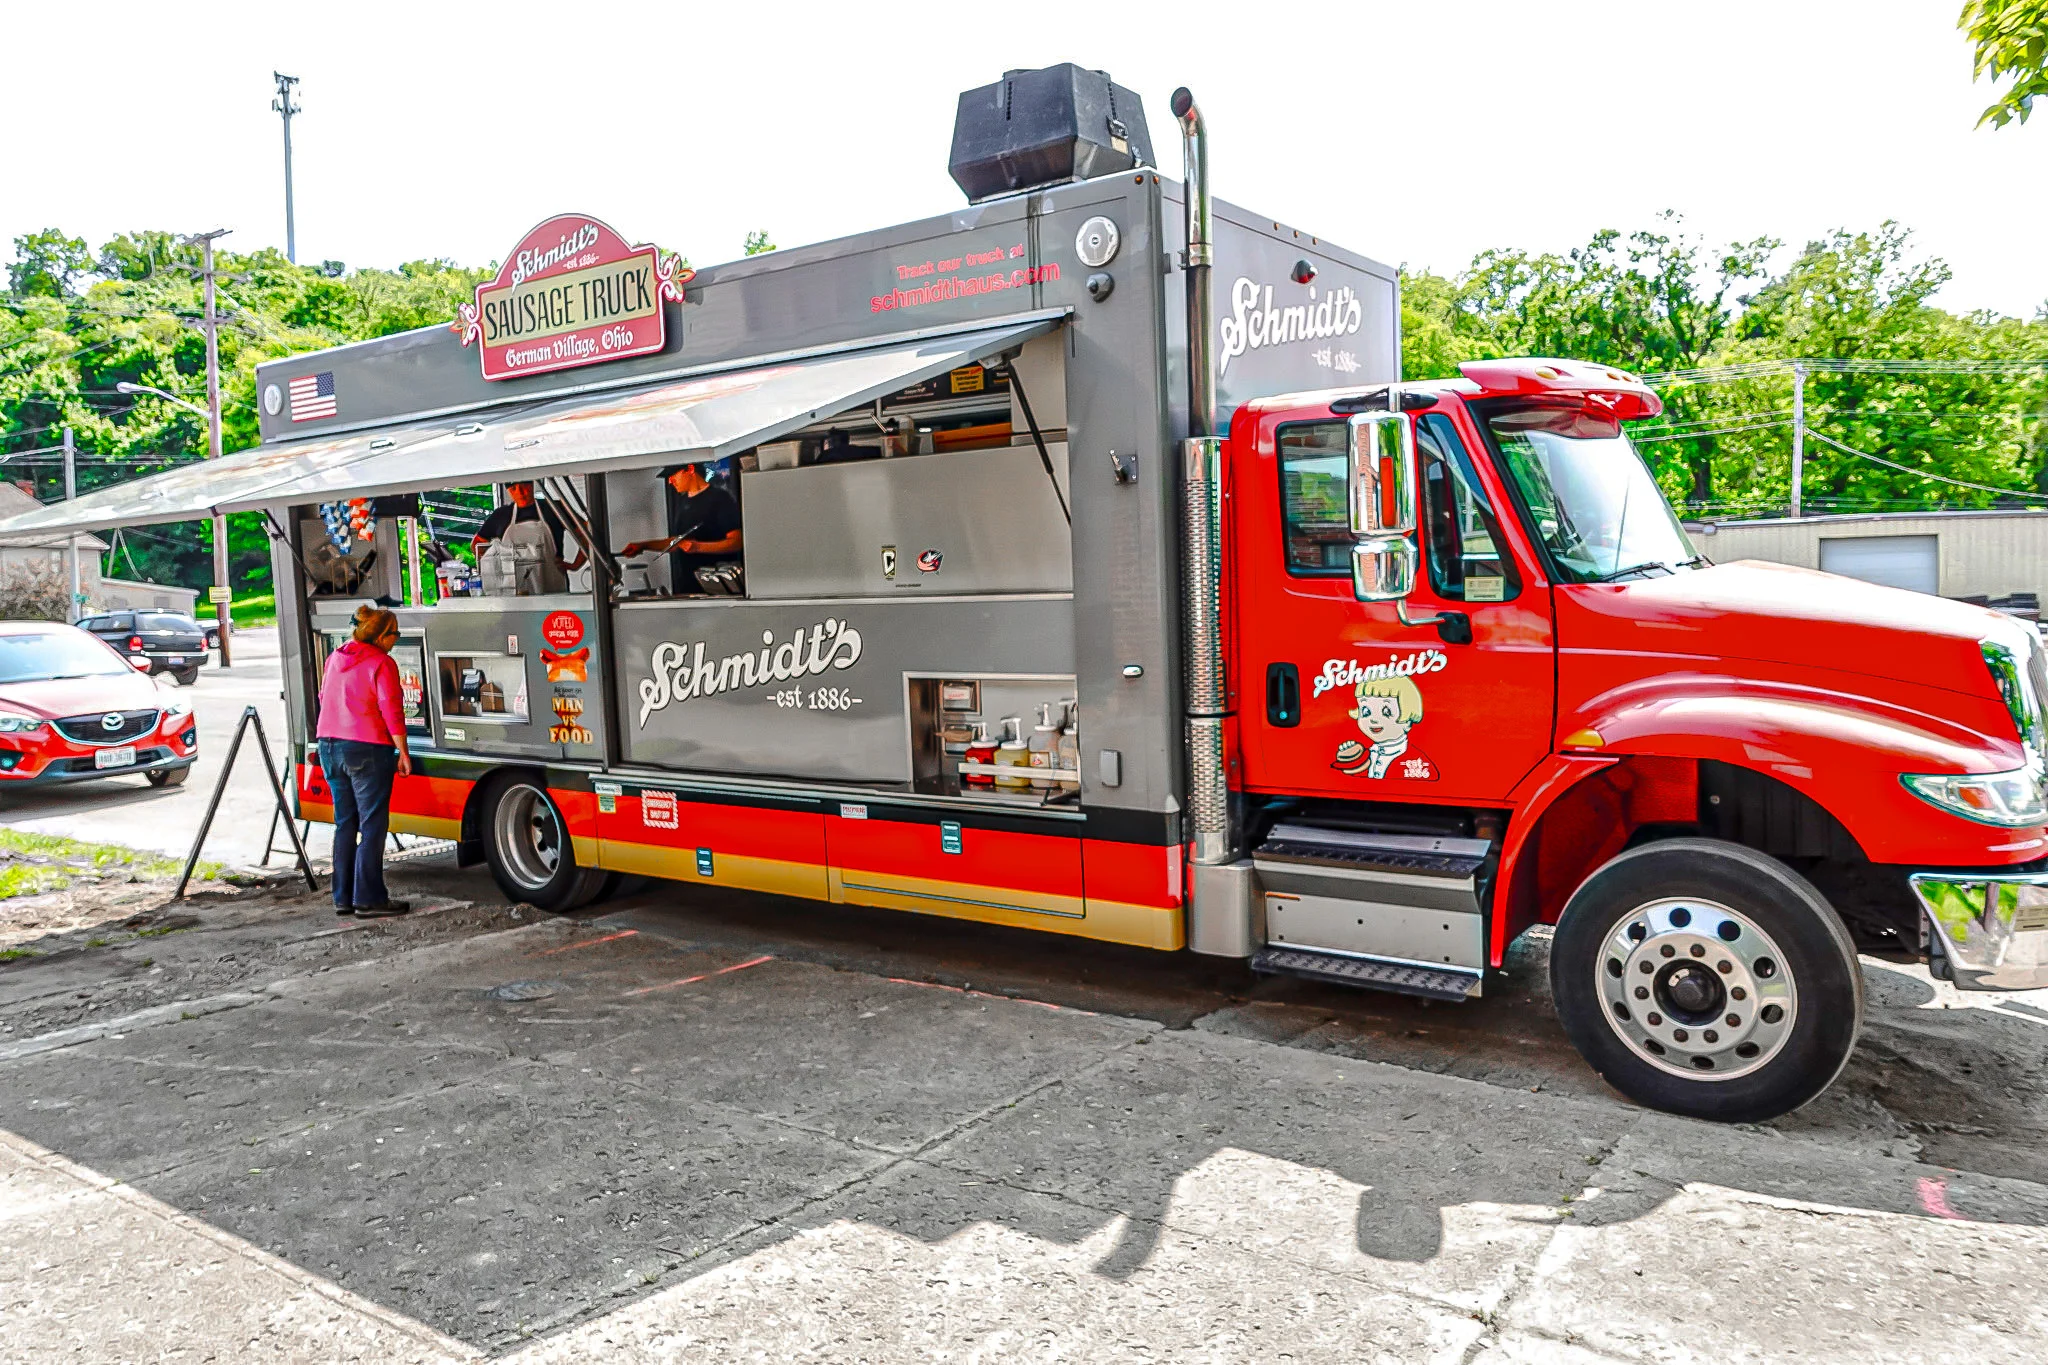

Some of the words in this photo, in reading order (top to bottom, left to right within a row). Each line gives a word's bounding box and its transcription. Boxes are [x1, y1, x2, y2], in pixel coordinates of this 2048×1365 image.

[511, 223, 599, 294] Schmidt's
[896, 261, 935, 280] Track
[937, 258, 962, 273] our
[965, 246, 1005, 266] truck
[1009, 243, 1025, 259] at
[485, 284, 575, 341] SAUSAGE
[578, 266, 652, 320] TRUCK
[870, 262, 1060, 313] schmidthaus.com
[505, 340, 552, 368] German
[553, 333, 599, 359] Village,
[601, 326, 634, 350] Ohio
[1220, 276, 1362, 377] Schmidt's
[639, 617, 863, 730] Schmidt's
[1313, 649, 1448, 699] Schmidt's
[552, 697, 584, 713] MAN
[548, 727, 593, 744] FOOD
